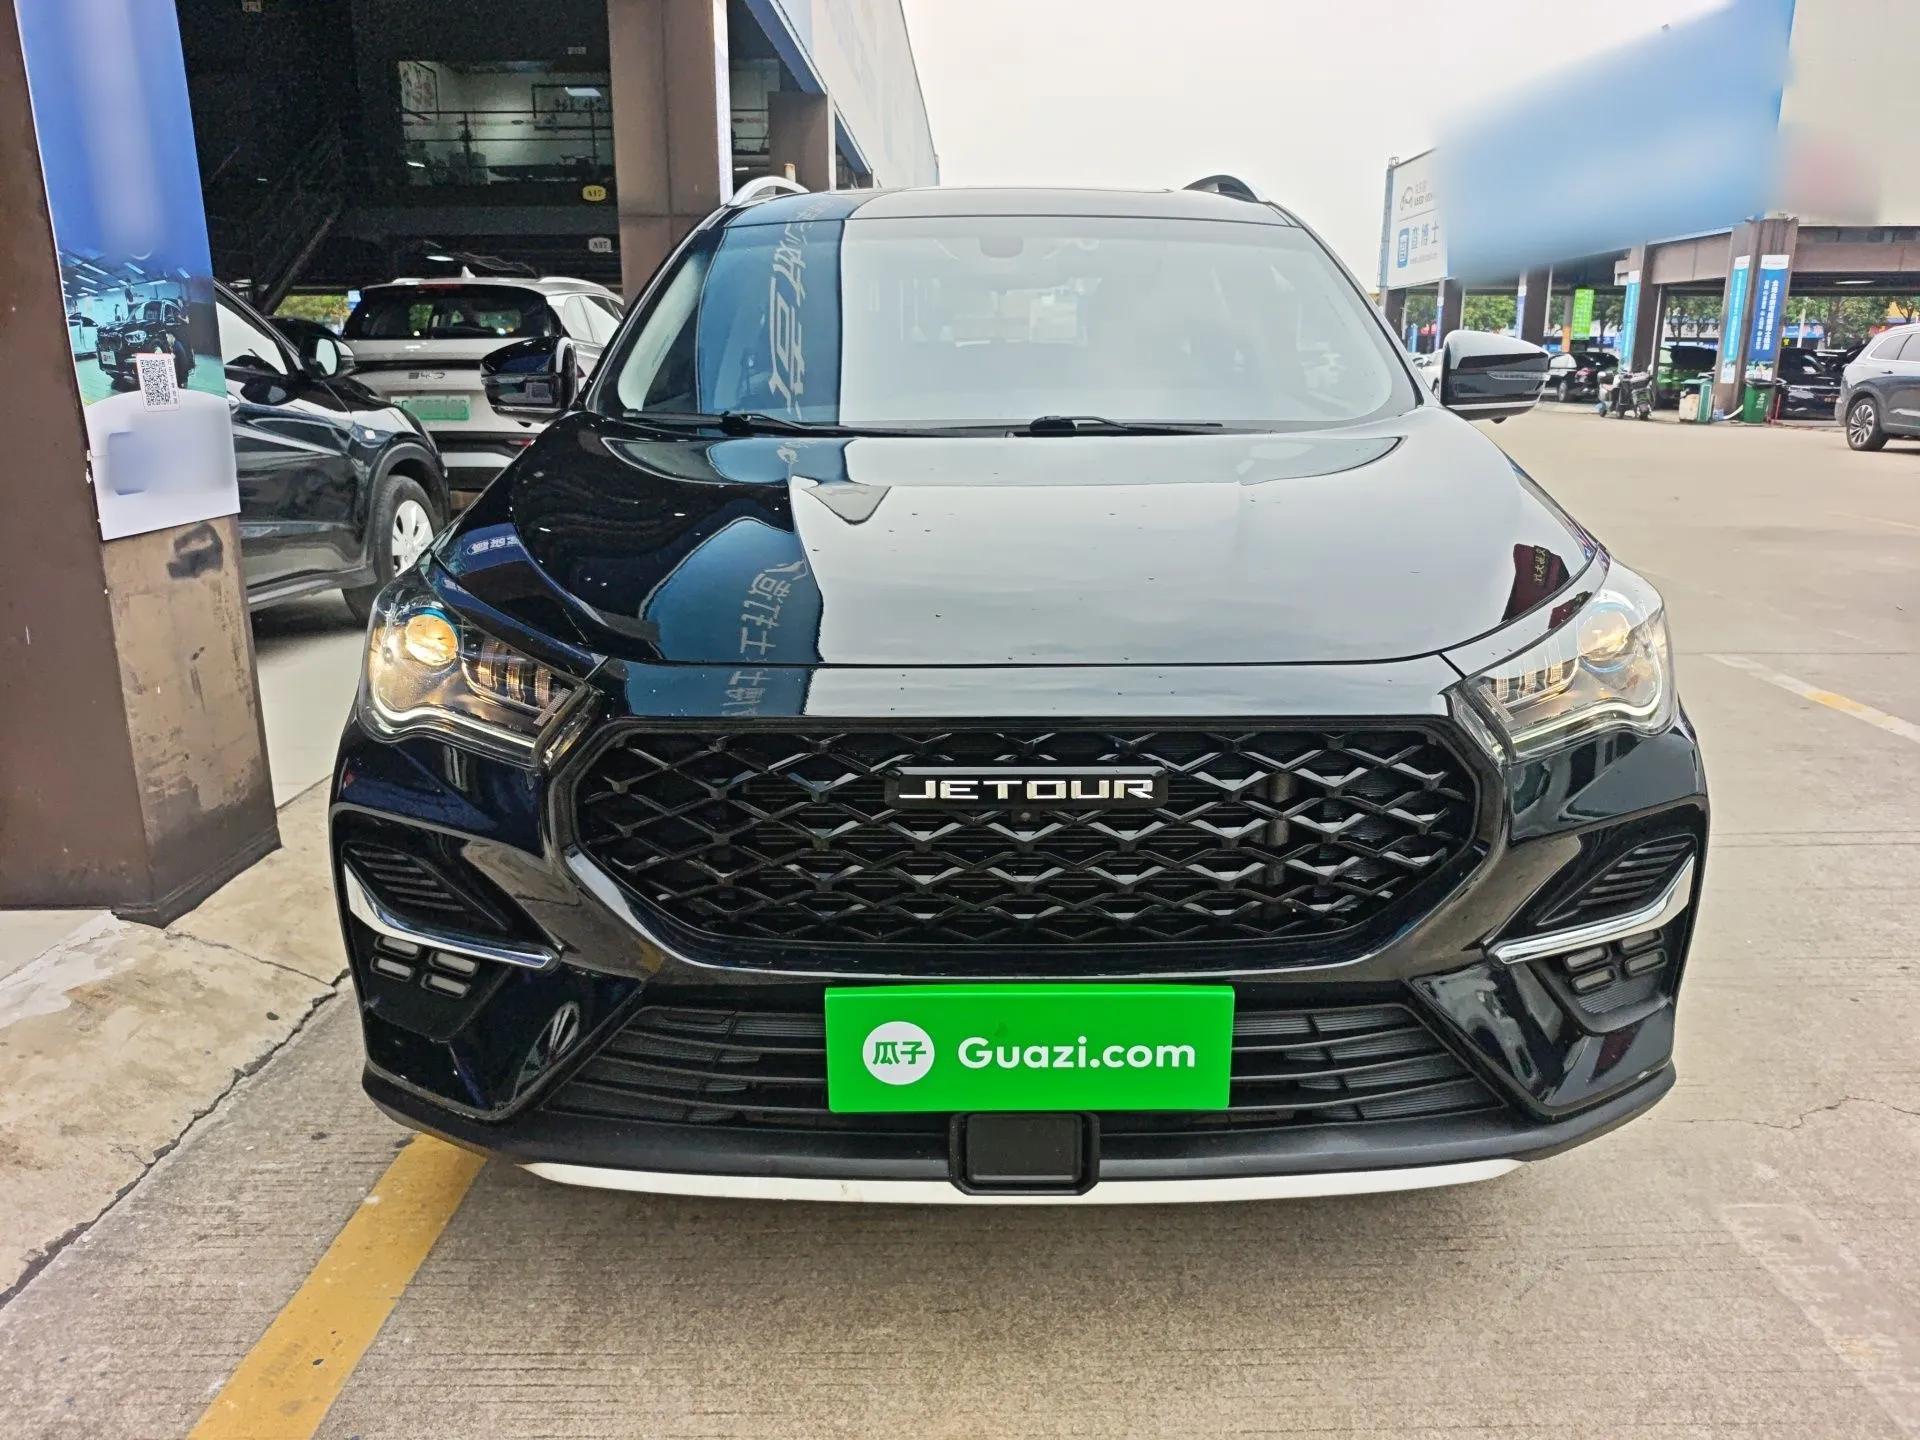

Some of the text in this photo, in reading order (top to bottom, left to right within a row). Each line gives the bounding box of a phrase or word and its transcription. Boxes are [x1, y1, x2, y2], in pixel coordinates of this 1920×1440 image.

[898, 779, 1154, 800] JETOUR
[871, 1040, 928, 1066] 瓜子
[957, 1035, 1196, 1069] Guazi.com
